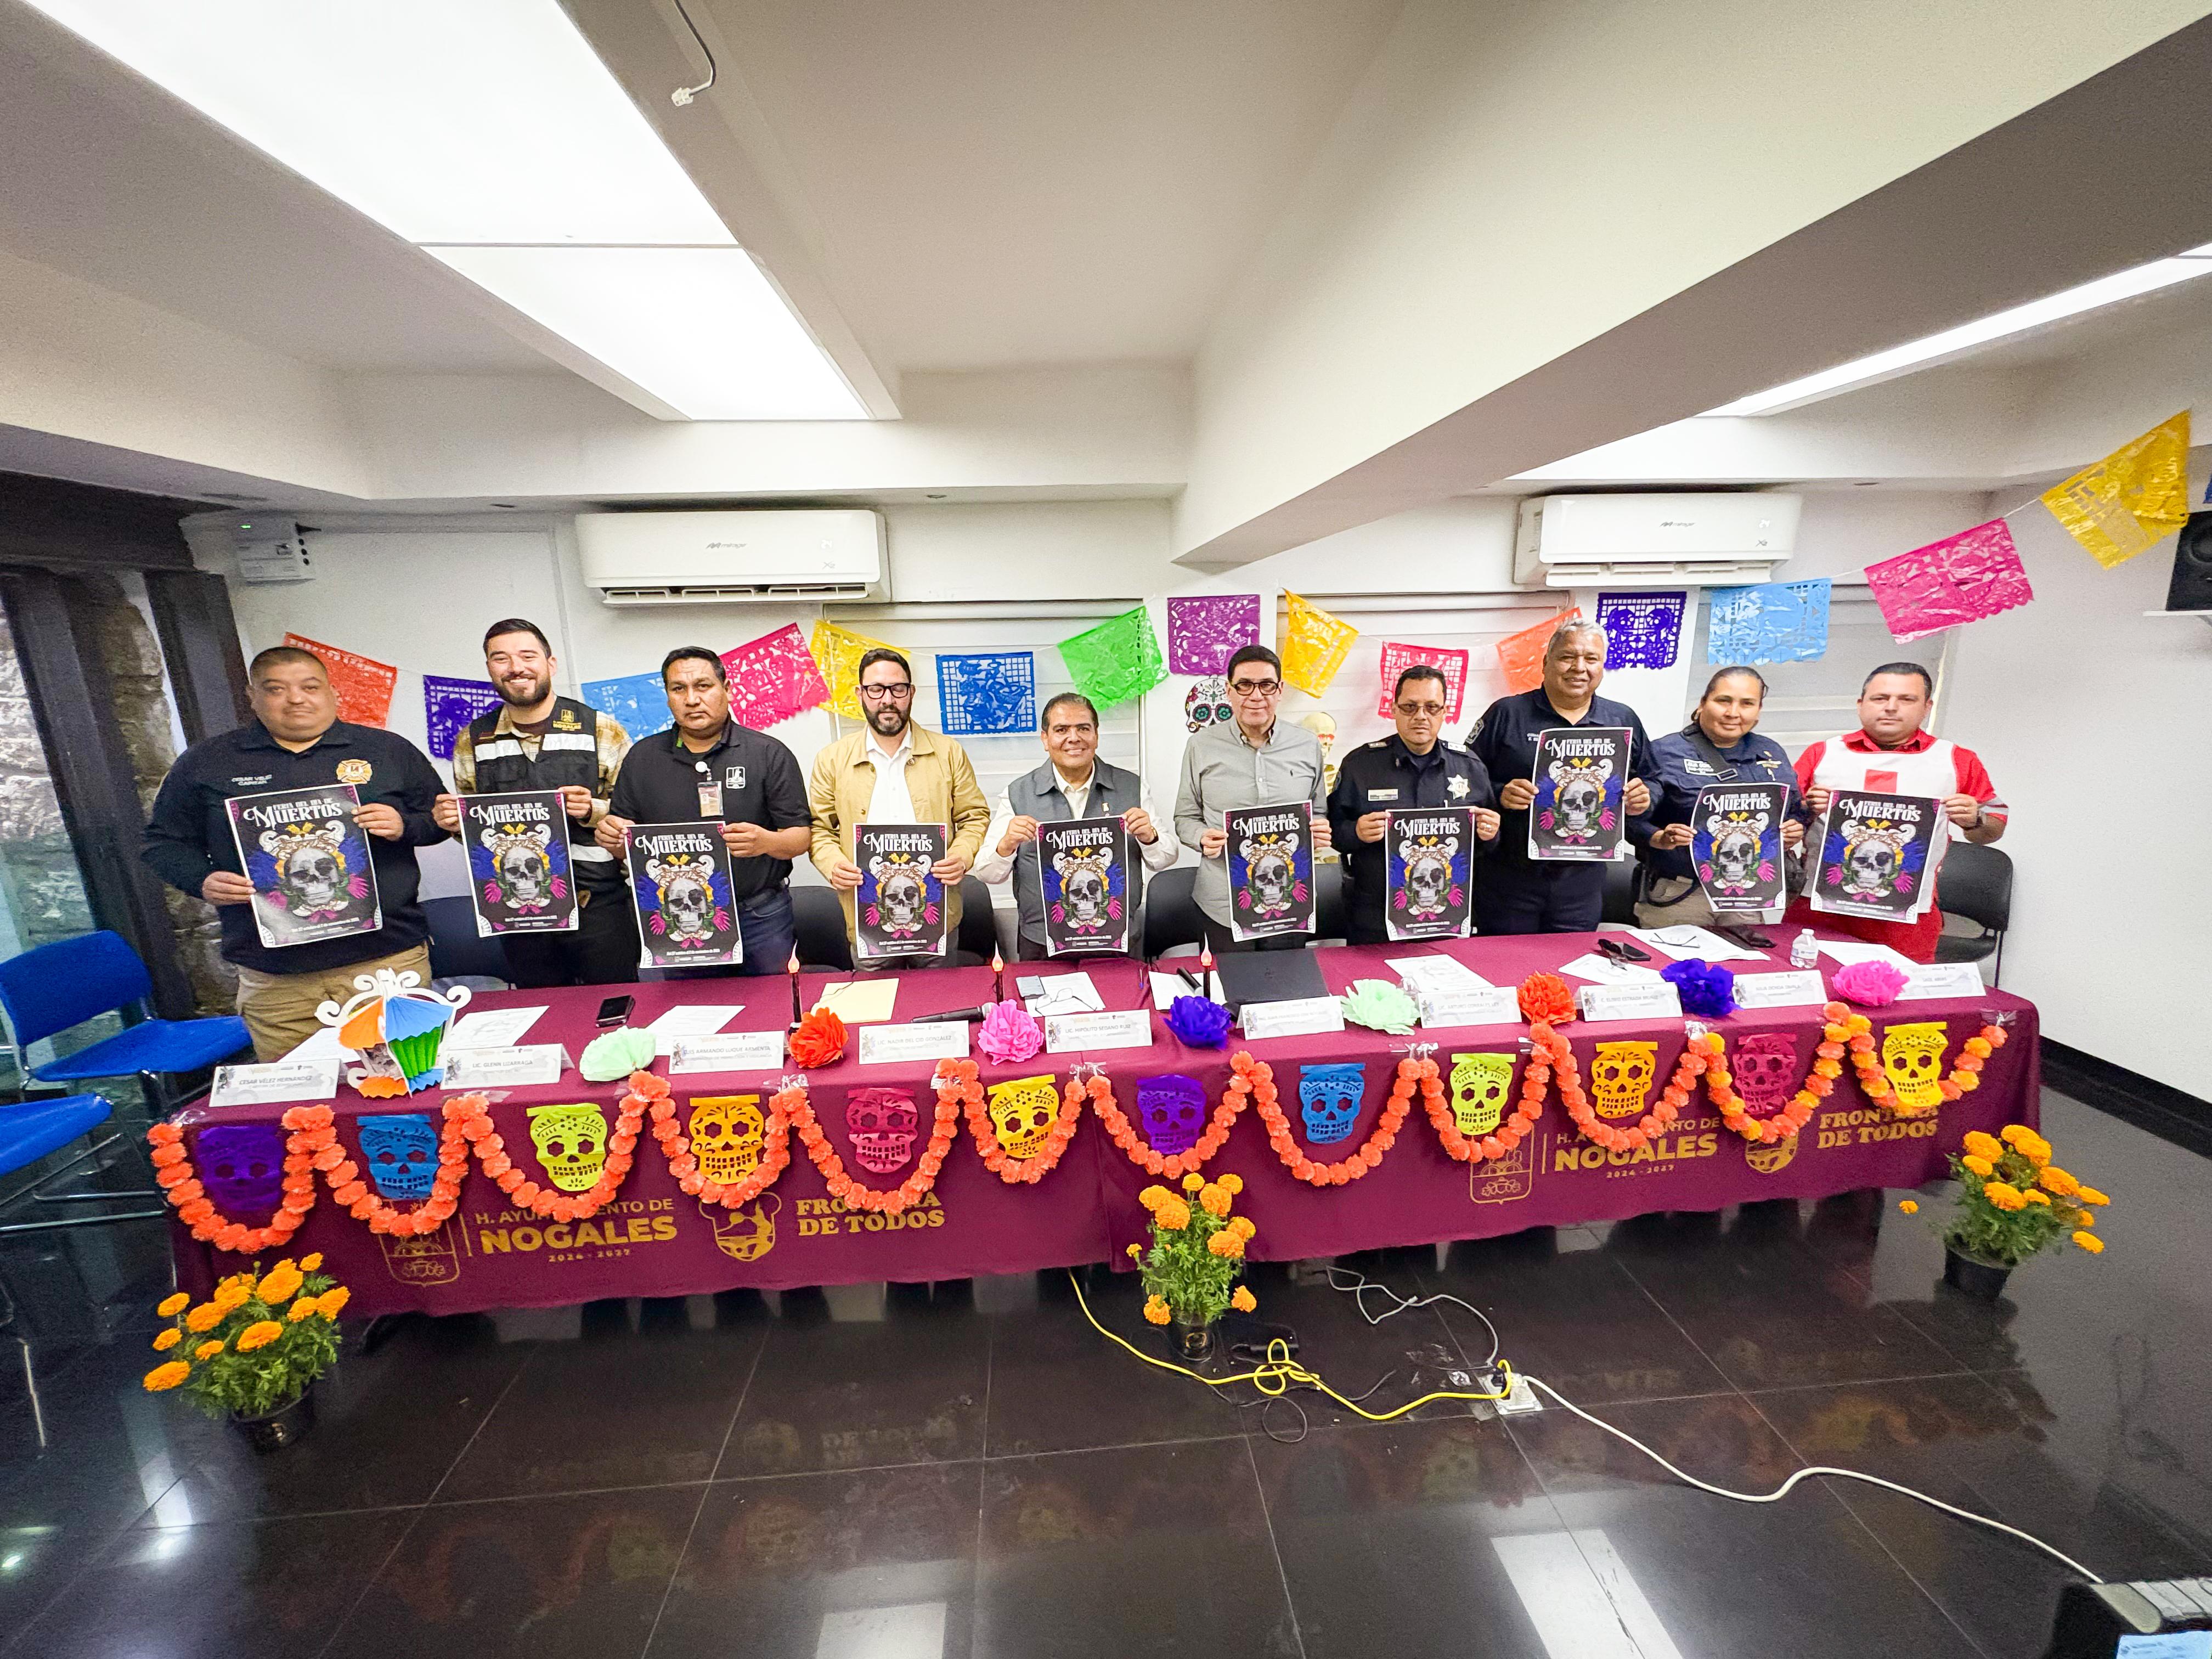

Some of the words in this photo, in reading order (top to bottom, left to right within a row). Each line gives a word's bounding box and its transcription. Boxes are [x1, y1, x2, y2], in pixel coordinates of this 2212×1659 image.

[1545, 738, 1616, 761] MUERTOS
[243, 803, 343, 830] MUERTOS
[469, 804, 550, 828] MUERTOS
[1703, 793, 1771, 816] MUERTOS
[1839, 798, 1922, 821] MUERTOS
[1233, 817, 1300, 840] MUERTOS
[1394, 818, 1460, 840] MUERTOS
[635, 834, 713, 859] MUERTOS
[863, 832, 933, 856] MUERTOS
[1046, 830, 1114, 852] MUERTOS
[1700, 1118, 1719, 1129] DE
[1817, 1130, 1852, 1148] DE
[1858, 1119, 1938, 1143] TODOS
[476, 1213, 494, 1224] H.
[649, 1198, 675, 1211] DE
[798, 1217, 839, 1236] DE
[844, 1209, 945, 1233] TODOS
[479, 1216, 678, 1255] NOGALES
